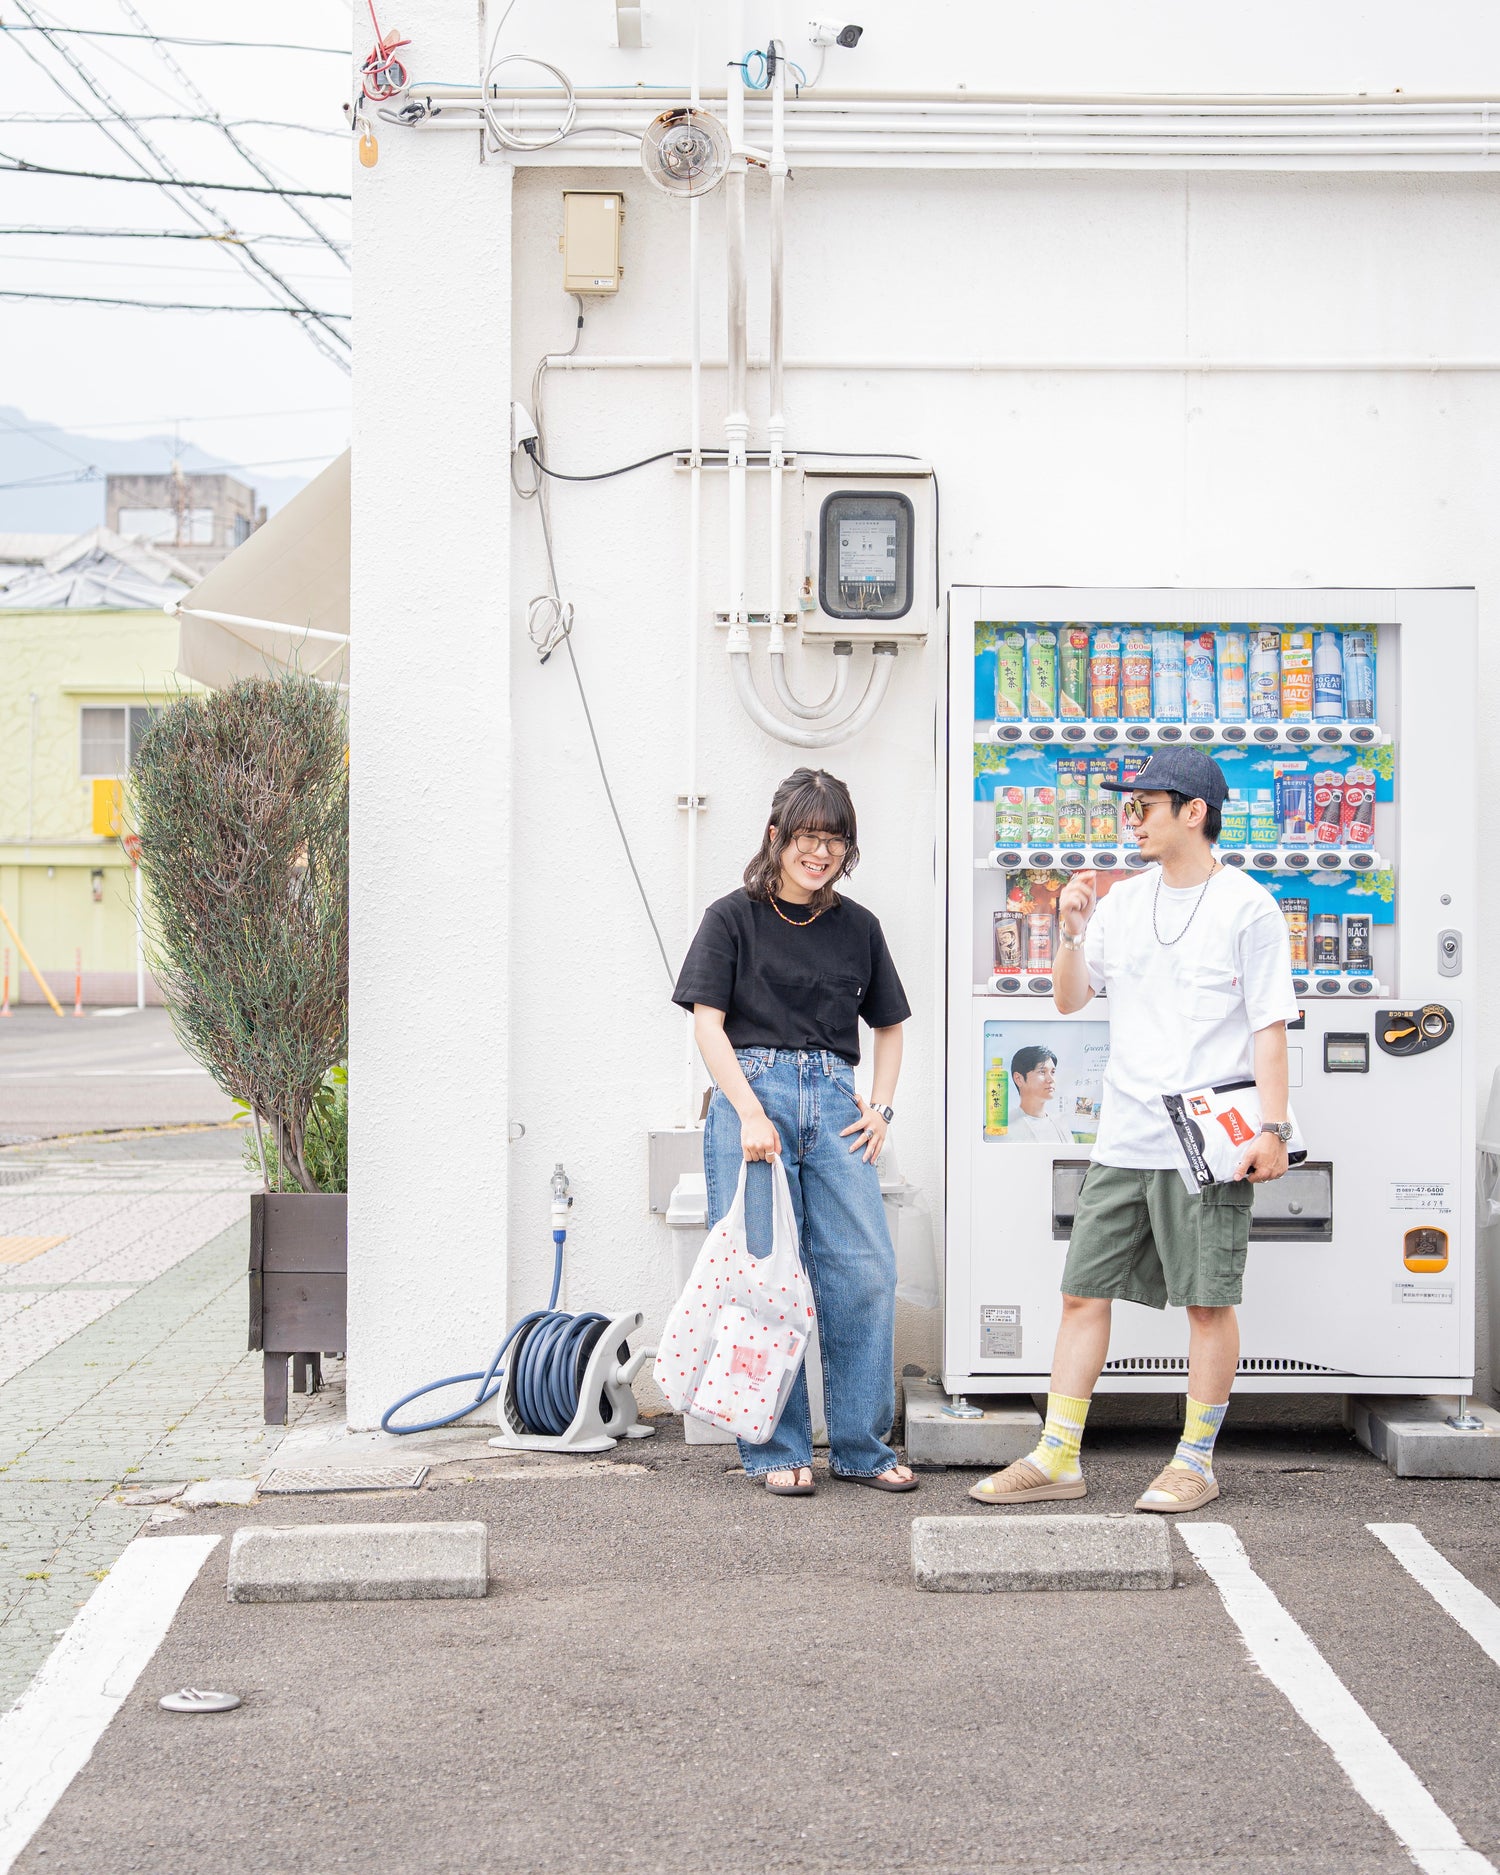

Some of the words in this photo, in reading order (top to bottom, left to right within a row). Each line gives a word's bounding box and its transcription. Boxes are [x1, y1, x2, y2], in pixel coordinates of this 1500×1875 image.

[1348, 928, 1368, 937] BLACK
[1228, 1112, 1244, 1141] Hanes
[1196, 1170, 1208, 1182] 2
